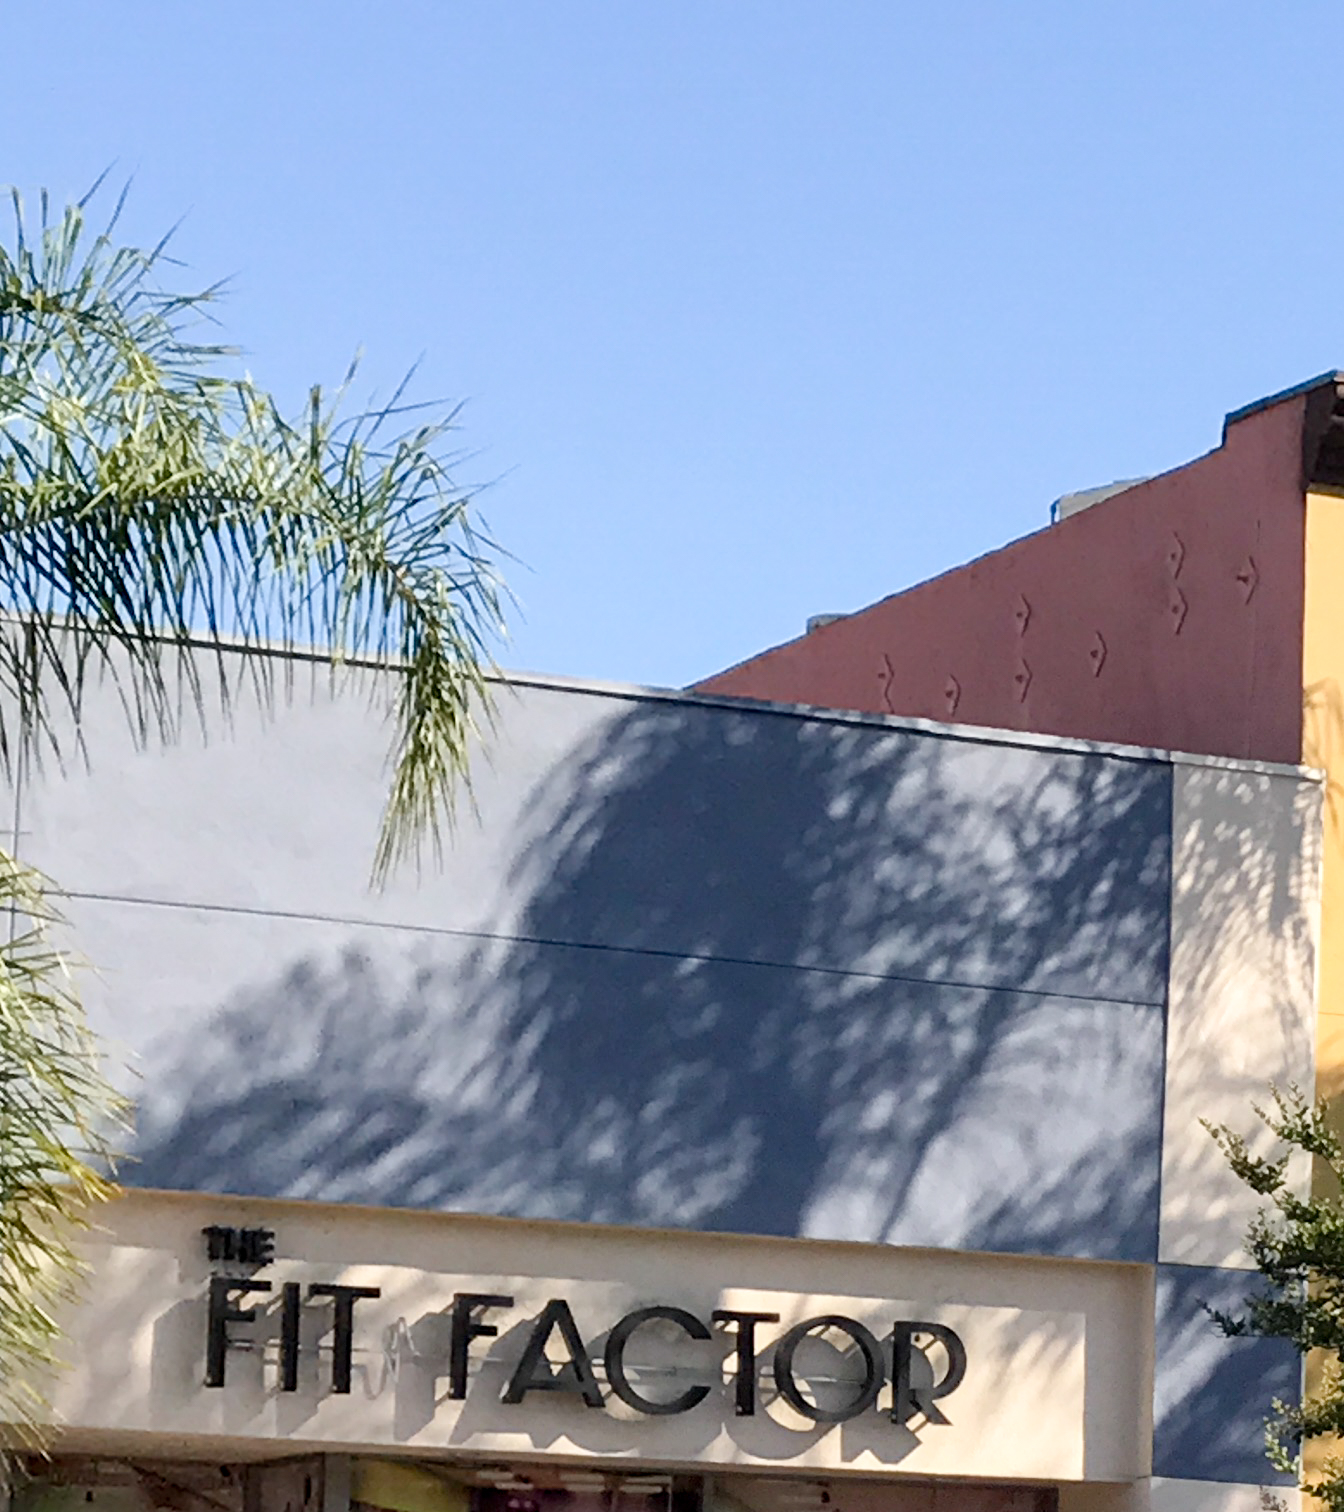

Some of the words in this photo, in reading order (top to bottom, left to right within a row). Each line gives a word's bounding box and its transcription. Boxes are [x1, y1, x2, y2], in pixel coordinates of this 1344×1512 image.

[202, 1225, 275, 1263] THE
[204, 1277, 381, 1395] FIT
[448, 1291, 967, 1427] FACTOR
